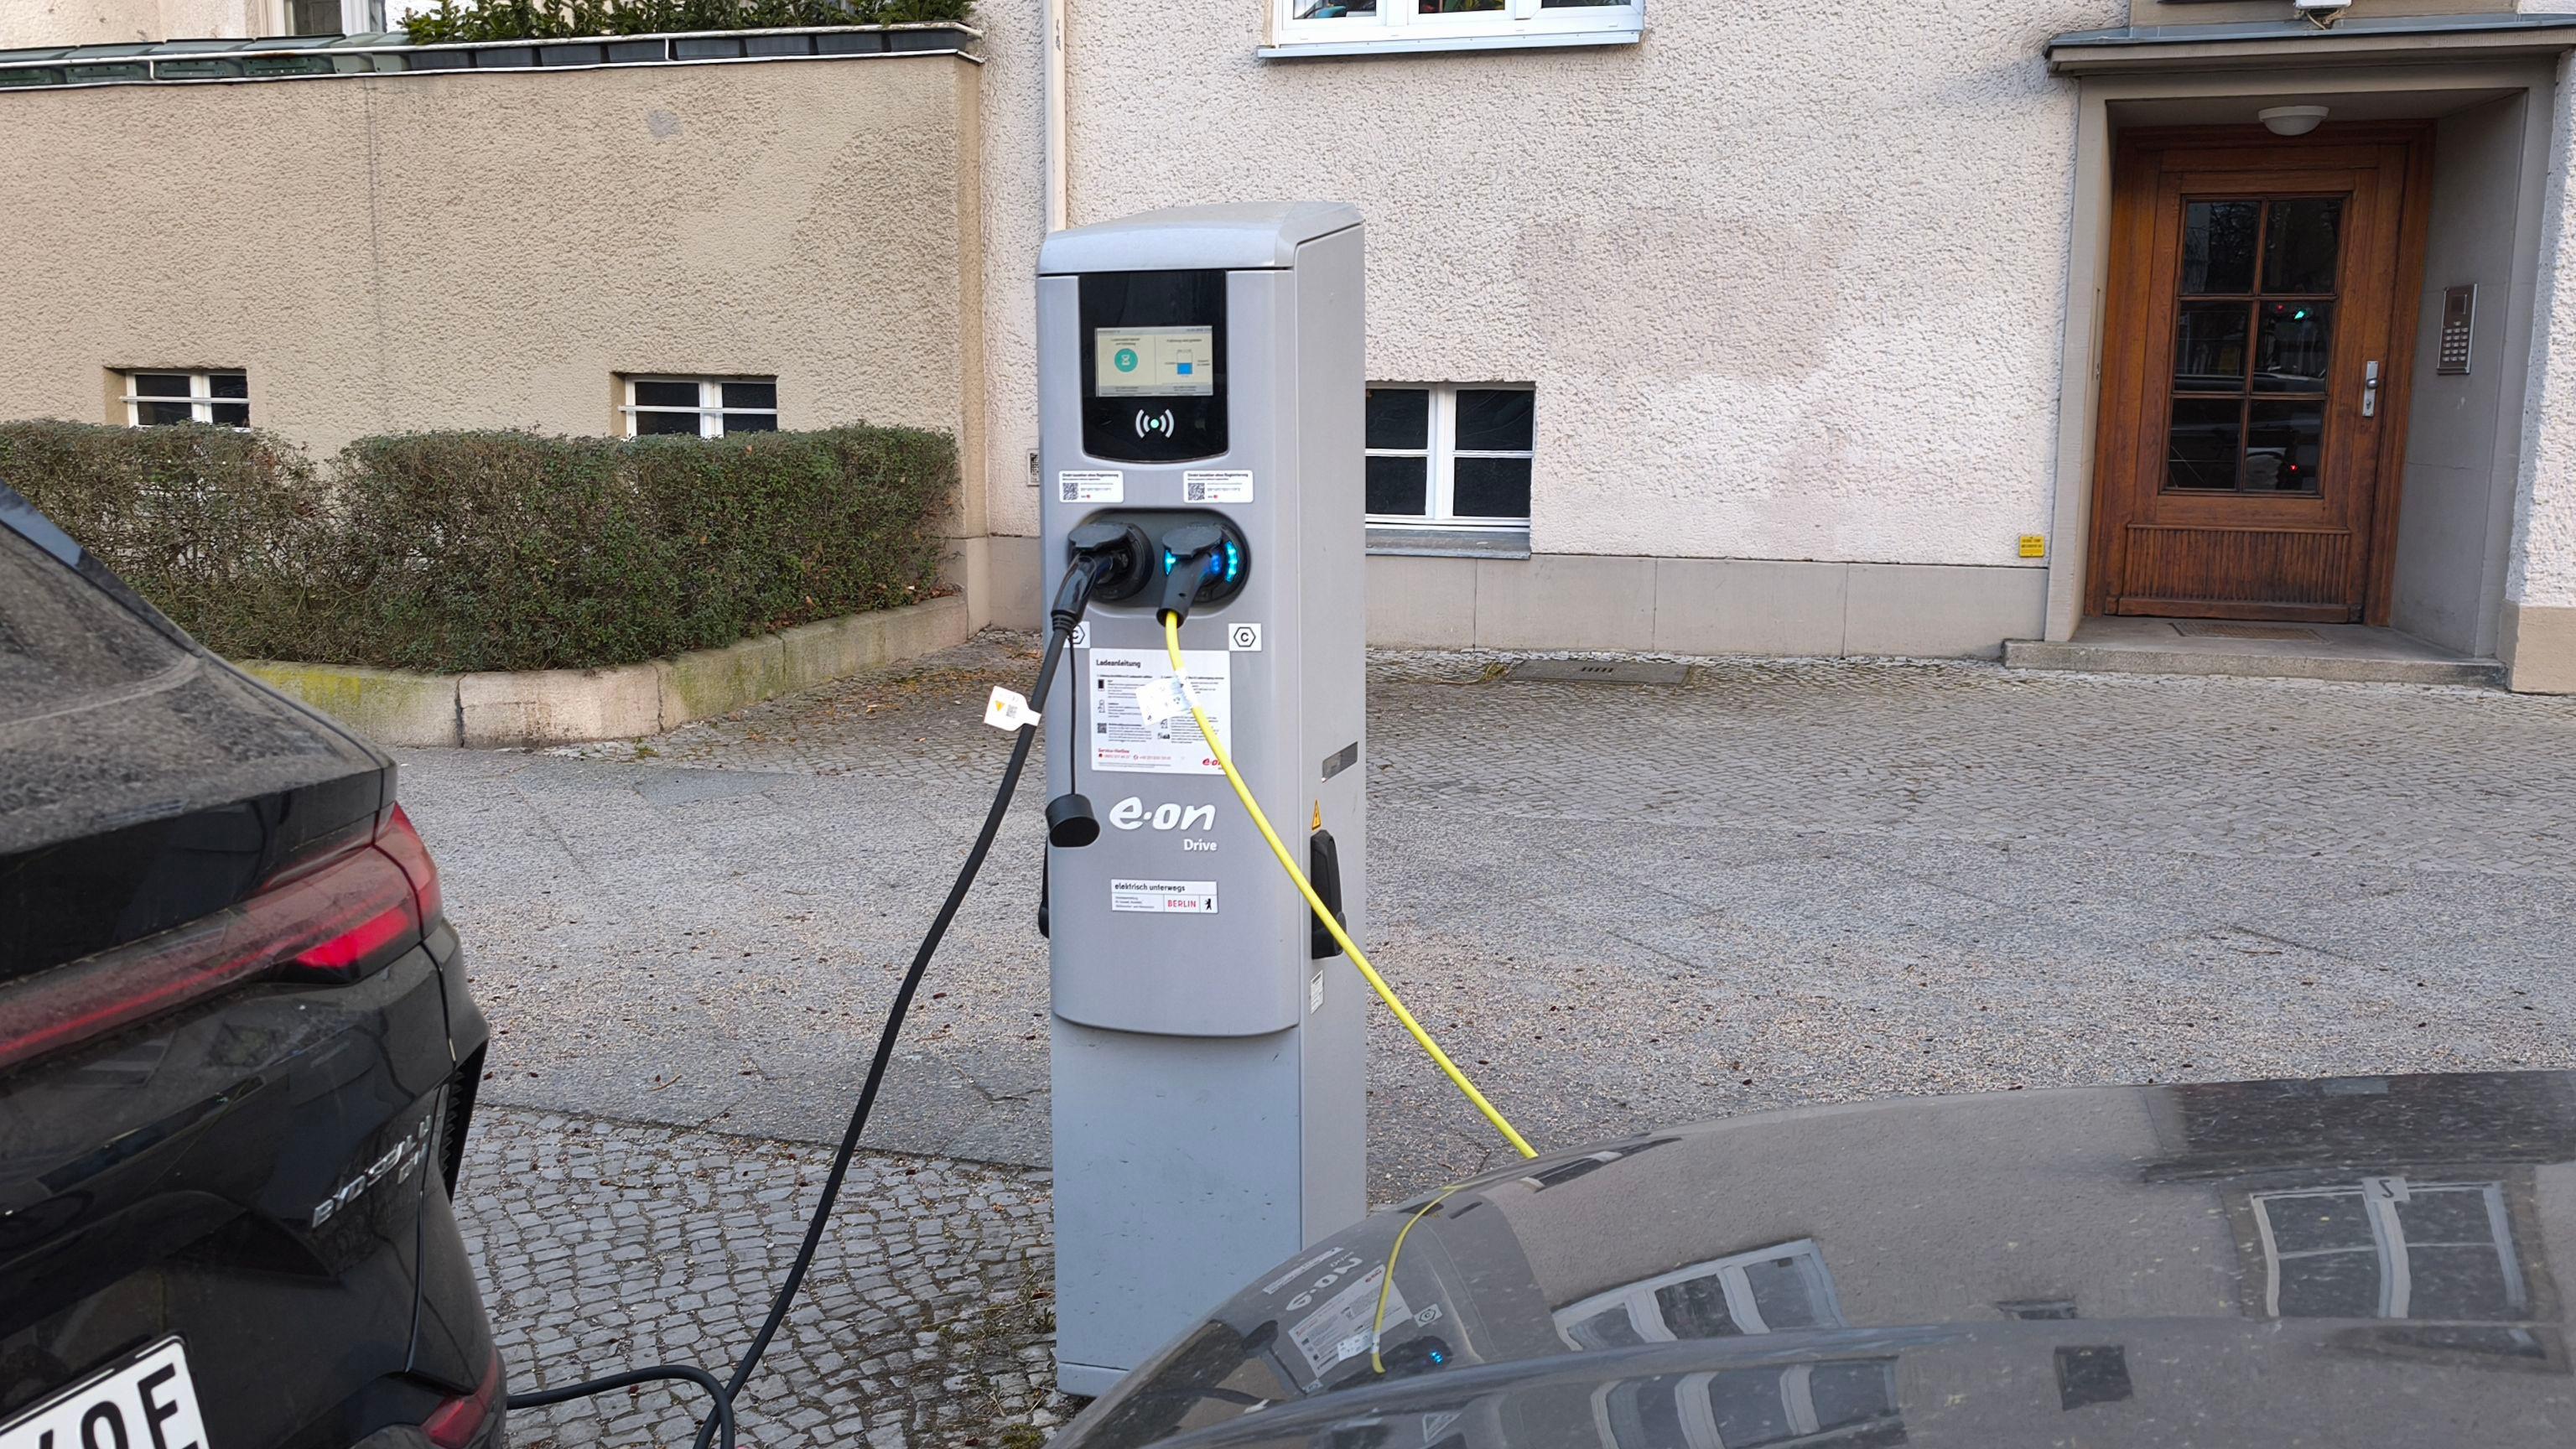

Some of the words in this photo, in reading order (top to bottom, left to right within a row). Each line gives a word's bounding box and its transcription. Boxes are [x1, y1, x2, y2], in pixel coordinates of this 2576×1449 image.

[1240, 631, 1249, 642] C
[1095, 659, 1141, 669] Ladeanleitung
[1183, 839, 1218, 851] Drive
[1114, 882, 1148, 891] elektrisch
[1149, 884, 1186, 893] unterwegs
[1167, 899, 1197, 908] BERLIN
